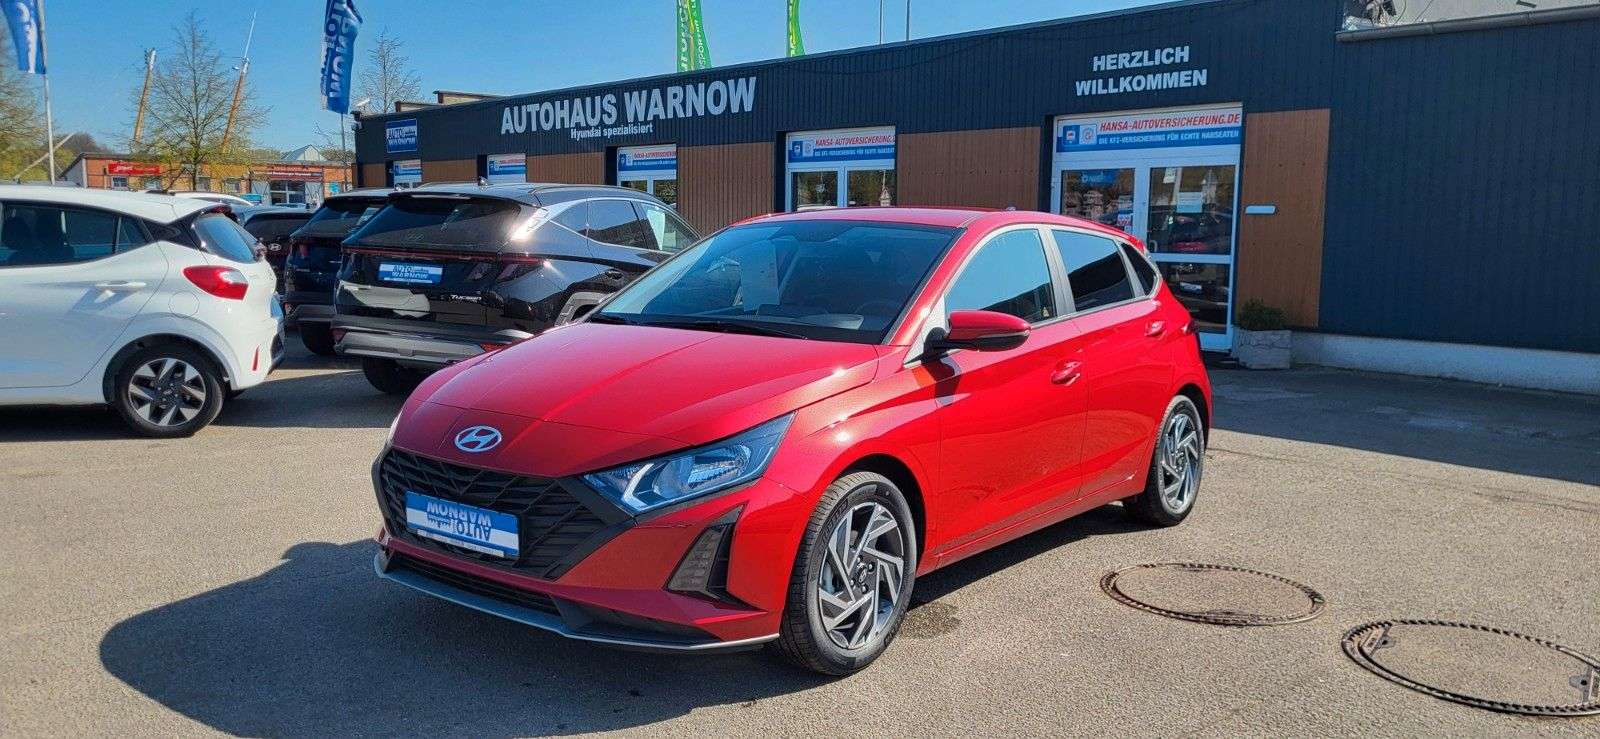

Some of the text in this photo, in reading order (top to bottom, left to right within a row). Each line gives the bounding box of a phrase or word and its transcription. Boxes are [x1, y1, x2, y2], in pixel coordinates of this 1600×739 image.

[1092, 46, 1189, 72] HERZLICH
[1075, 69, 1208, 96] WILLKOMMEN
[501, 76, 757, 135] AUTOHAUS WARNOW
[570, 123, 653, 142] Hyundai spezialisiert
[1100, 113, 1240, 132] HANSA-AUTOVERSICHERUNG.DE
[392, 271, 429, 279] WARNOW
[393, 264, 413, 273] AUTO
[426, 501, 492, 527] WARNOW
[457, 520, 492, 542] AUTO
